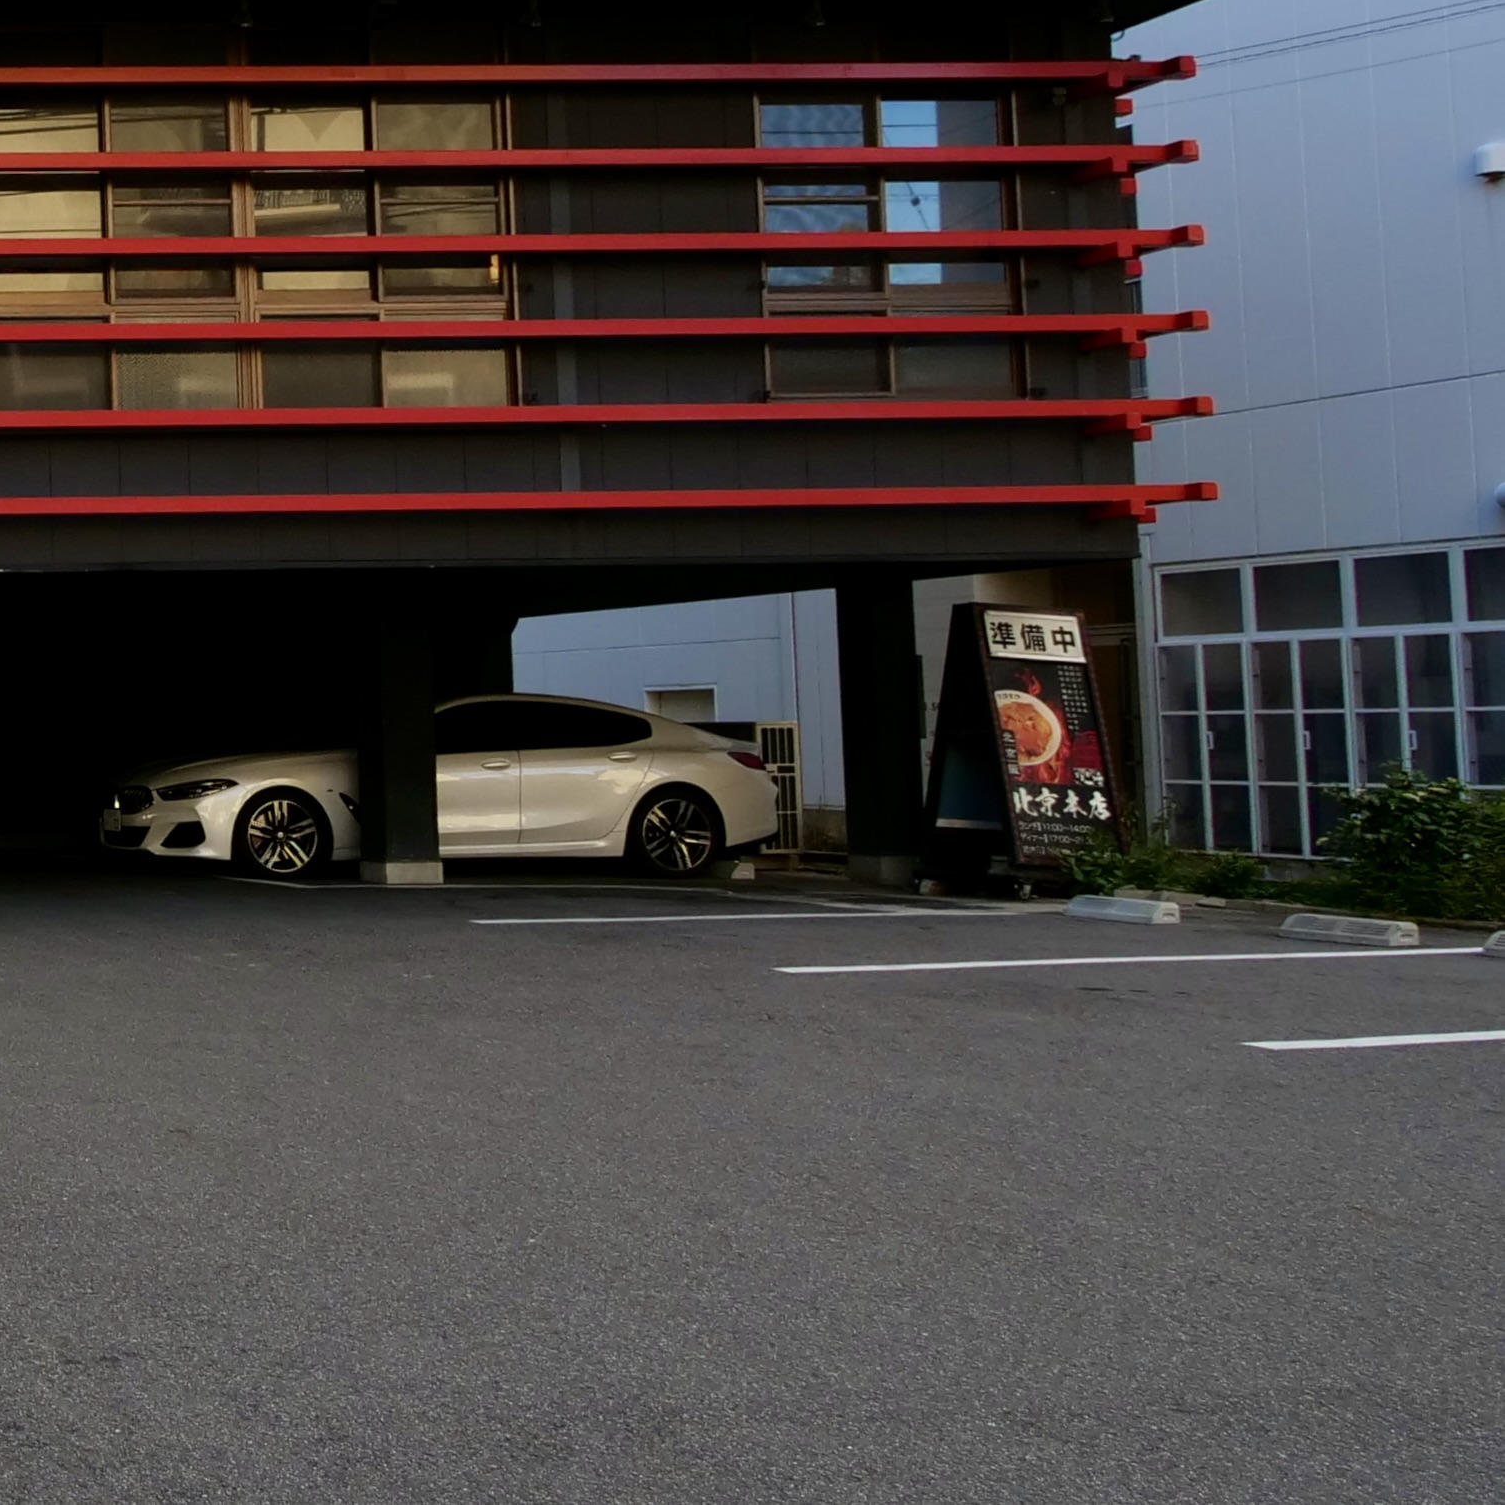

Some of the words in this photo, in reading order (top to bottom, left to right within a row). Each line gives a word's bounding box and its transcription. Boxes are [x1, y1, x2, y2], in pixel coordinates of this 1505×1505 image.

[989, 620, 1076, 654] 準備中
[1012, 786, 1112, 821] 北京本店
